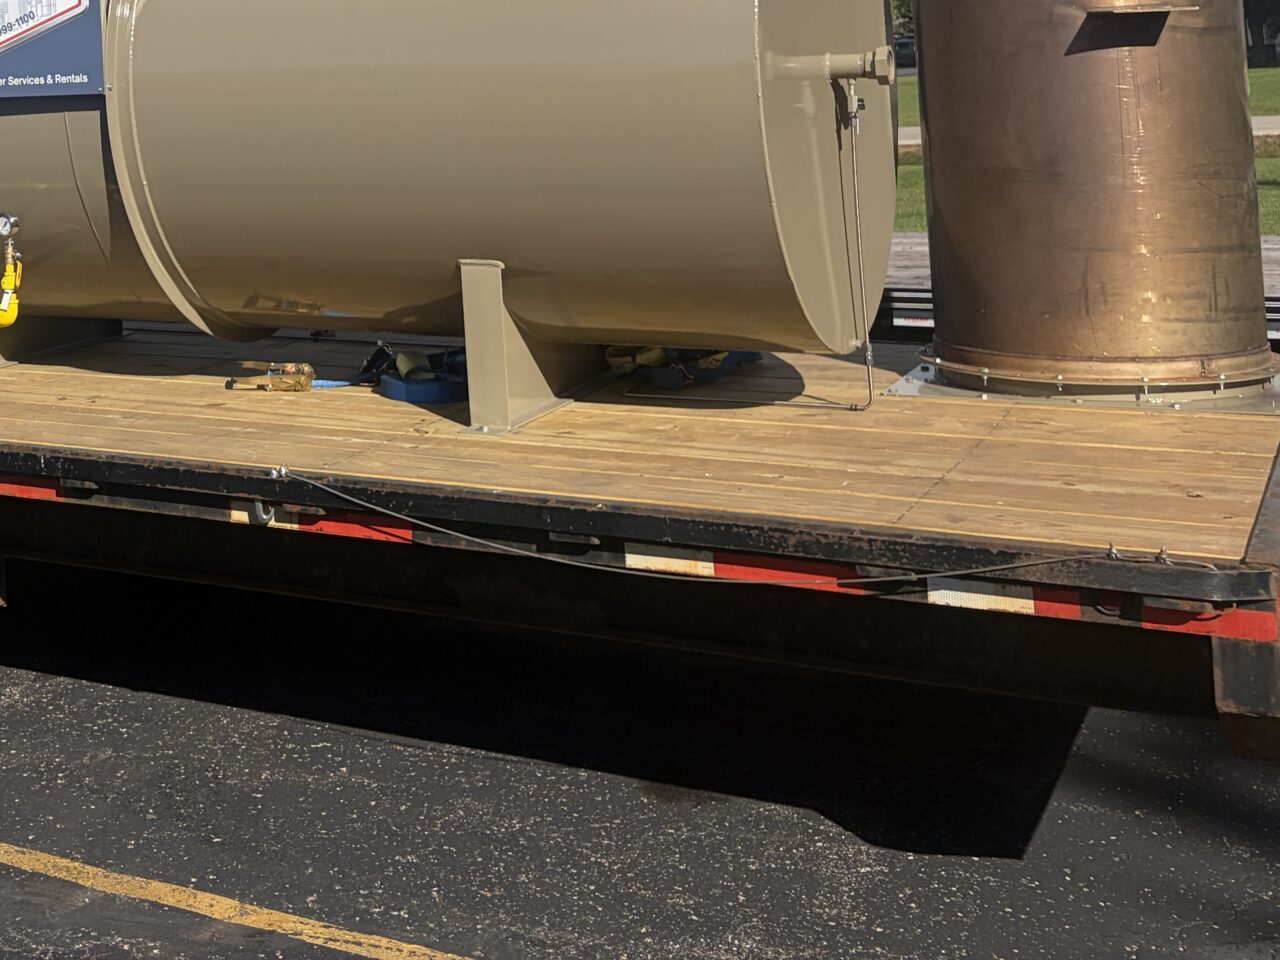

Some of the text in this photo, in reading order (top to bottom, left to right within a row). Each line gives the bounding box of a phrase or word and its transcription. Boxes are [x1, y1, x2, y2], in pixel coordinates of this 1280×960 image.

[7, 75, 45, 86] Services
[46, 73, 54, 84] &
[55, 73, 89, 84] Rentals
